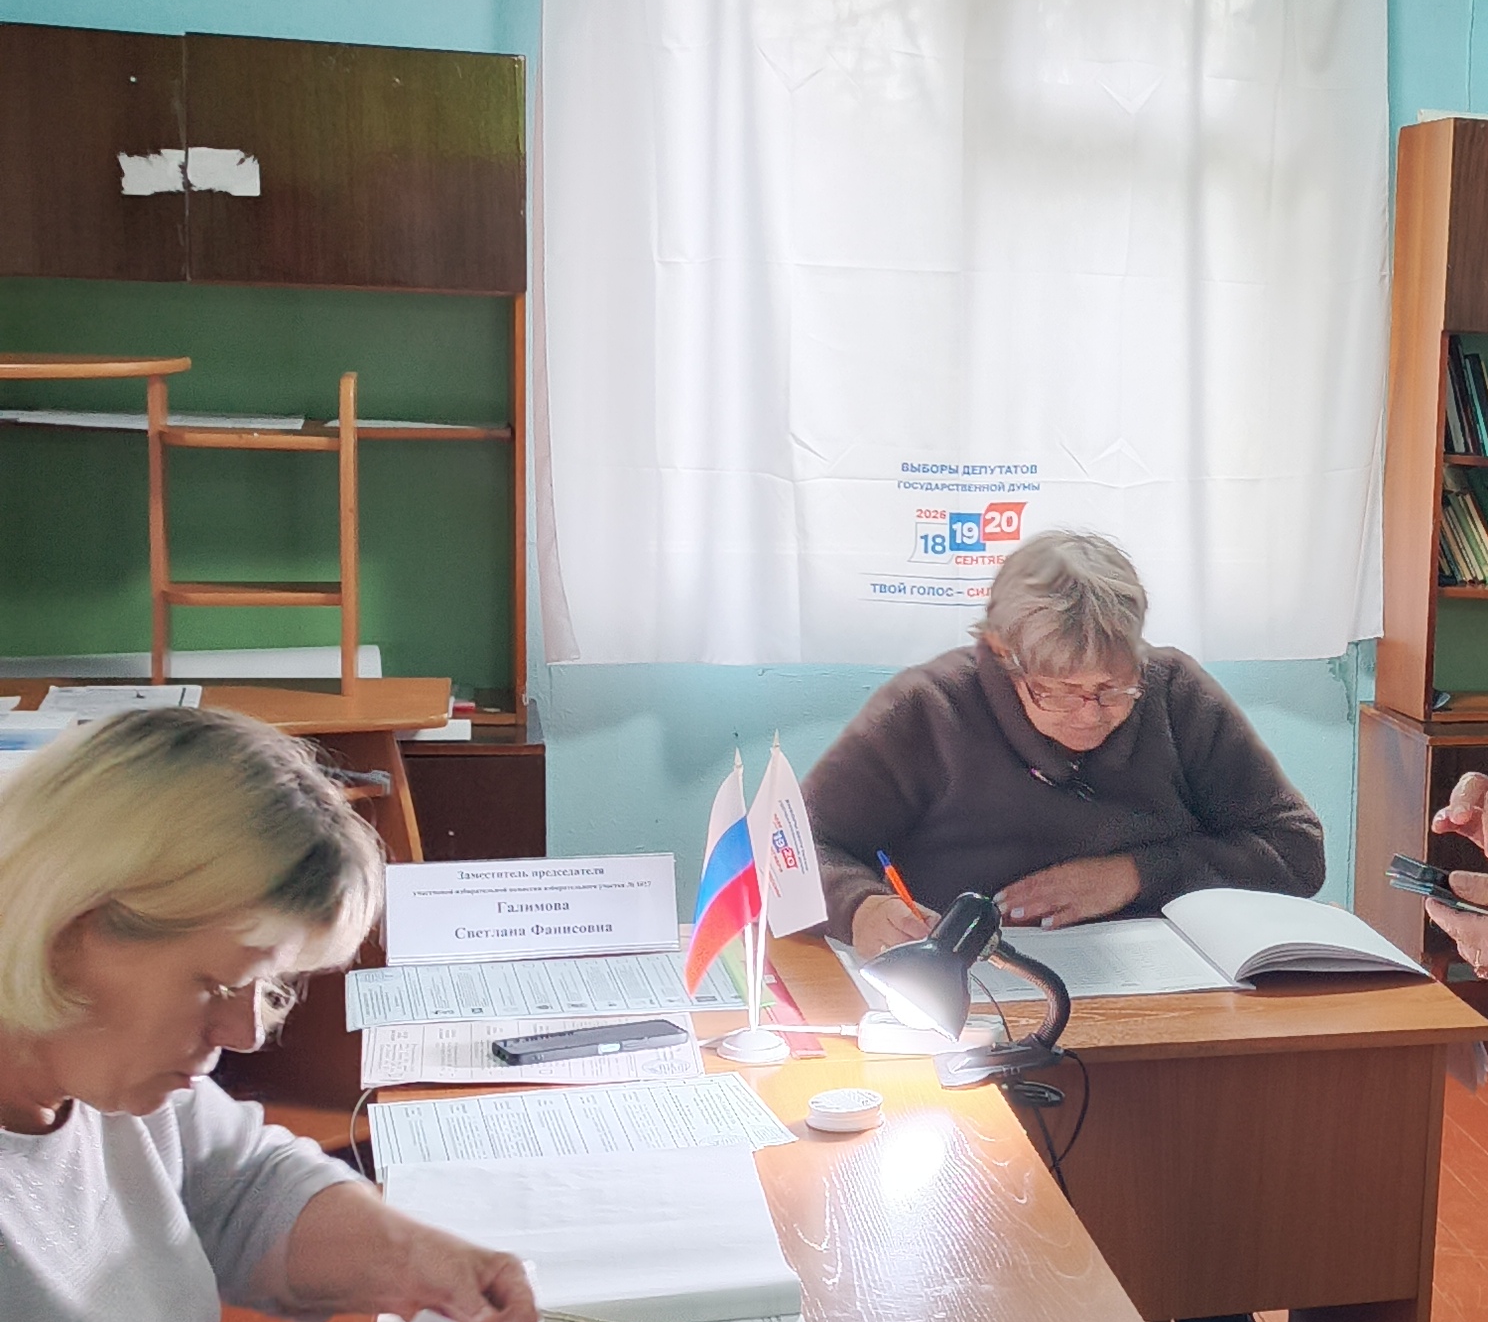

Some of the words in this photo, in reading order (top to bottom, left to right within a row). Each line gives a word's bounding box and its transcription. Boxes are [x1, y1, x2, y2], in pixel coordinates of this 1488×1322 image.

[902, 462, 959, 475] ВЫБОРЫ
[962, 464, 1038, 476] ДЕПУТАТОВ
[897, 480, 1005, 493] ГОСУДАРСТВЕННОЙ
[1007, 482, 1040, 493] ДУМЫ
[916, 509, 947, 520] 2026
[920, 534, 946, 554] 18
[952, 521, 979, 544] 19
[984, 510, 1019, 533] 20
[955, 555, 1005, 565] СЕНТЯБ
[870, 582, 906, 594] ТВОЙ
[910, 584, 954, 597] ГОЛОС
[967, 587, 991, 597] СИЛ
[457, 870, 529, 880] Заместитель
[531, 867, 605, 879] председателя
[497, 901, 570, 913] Галимова
[454, 927, 526, 940] Светлана
[530, 923, 613, 936] Фанисовна
